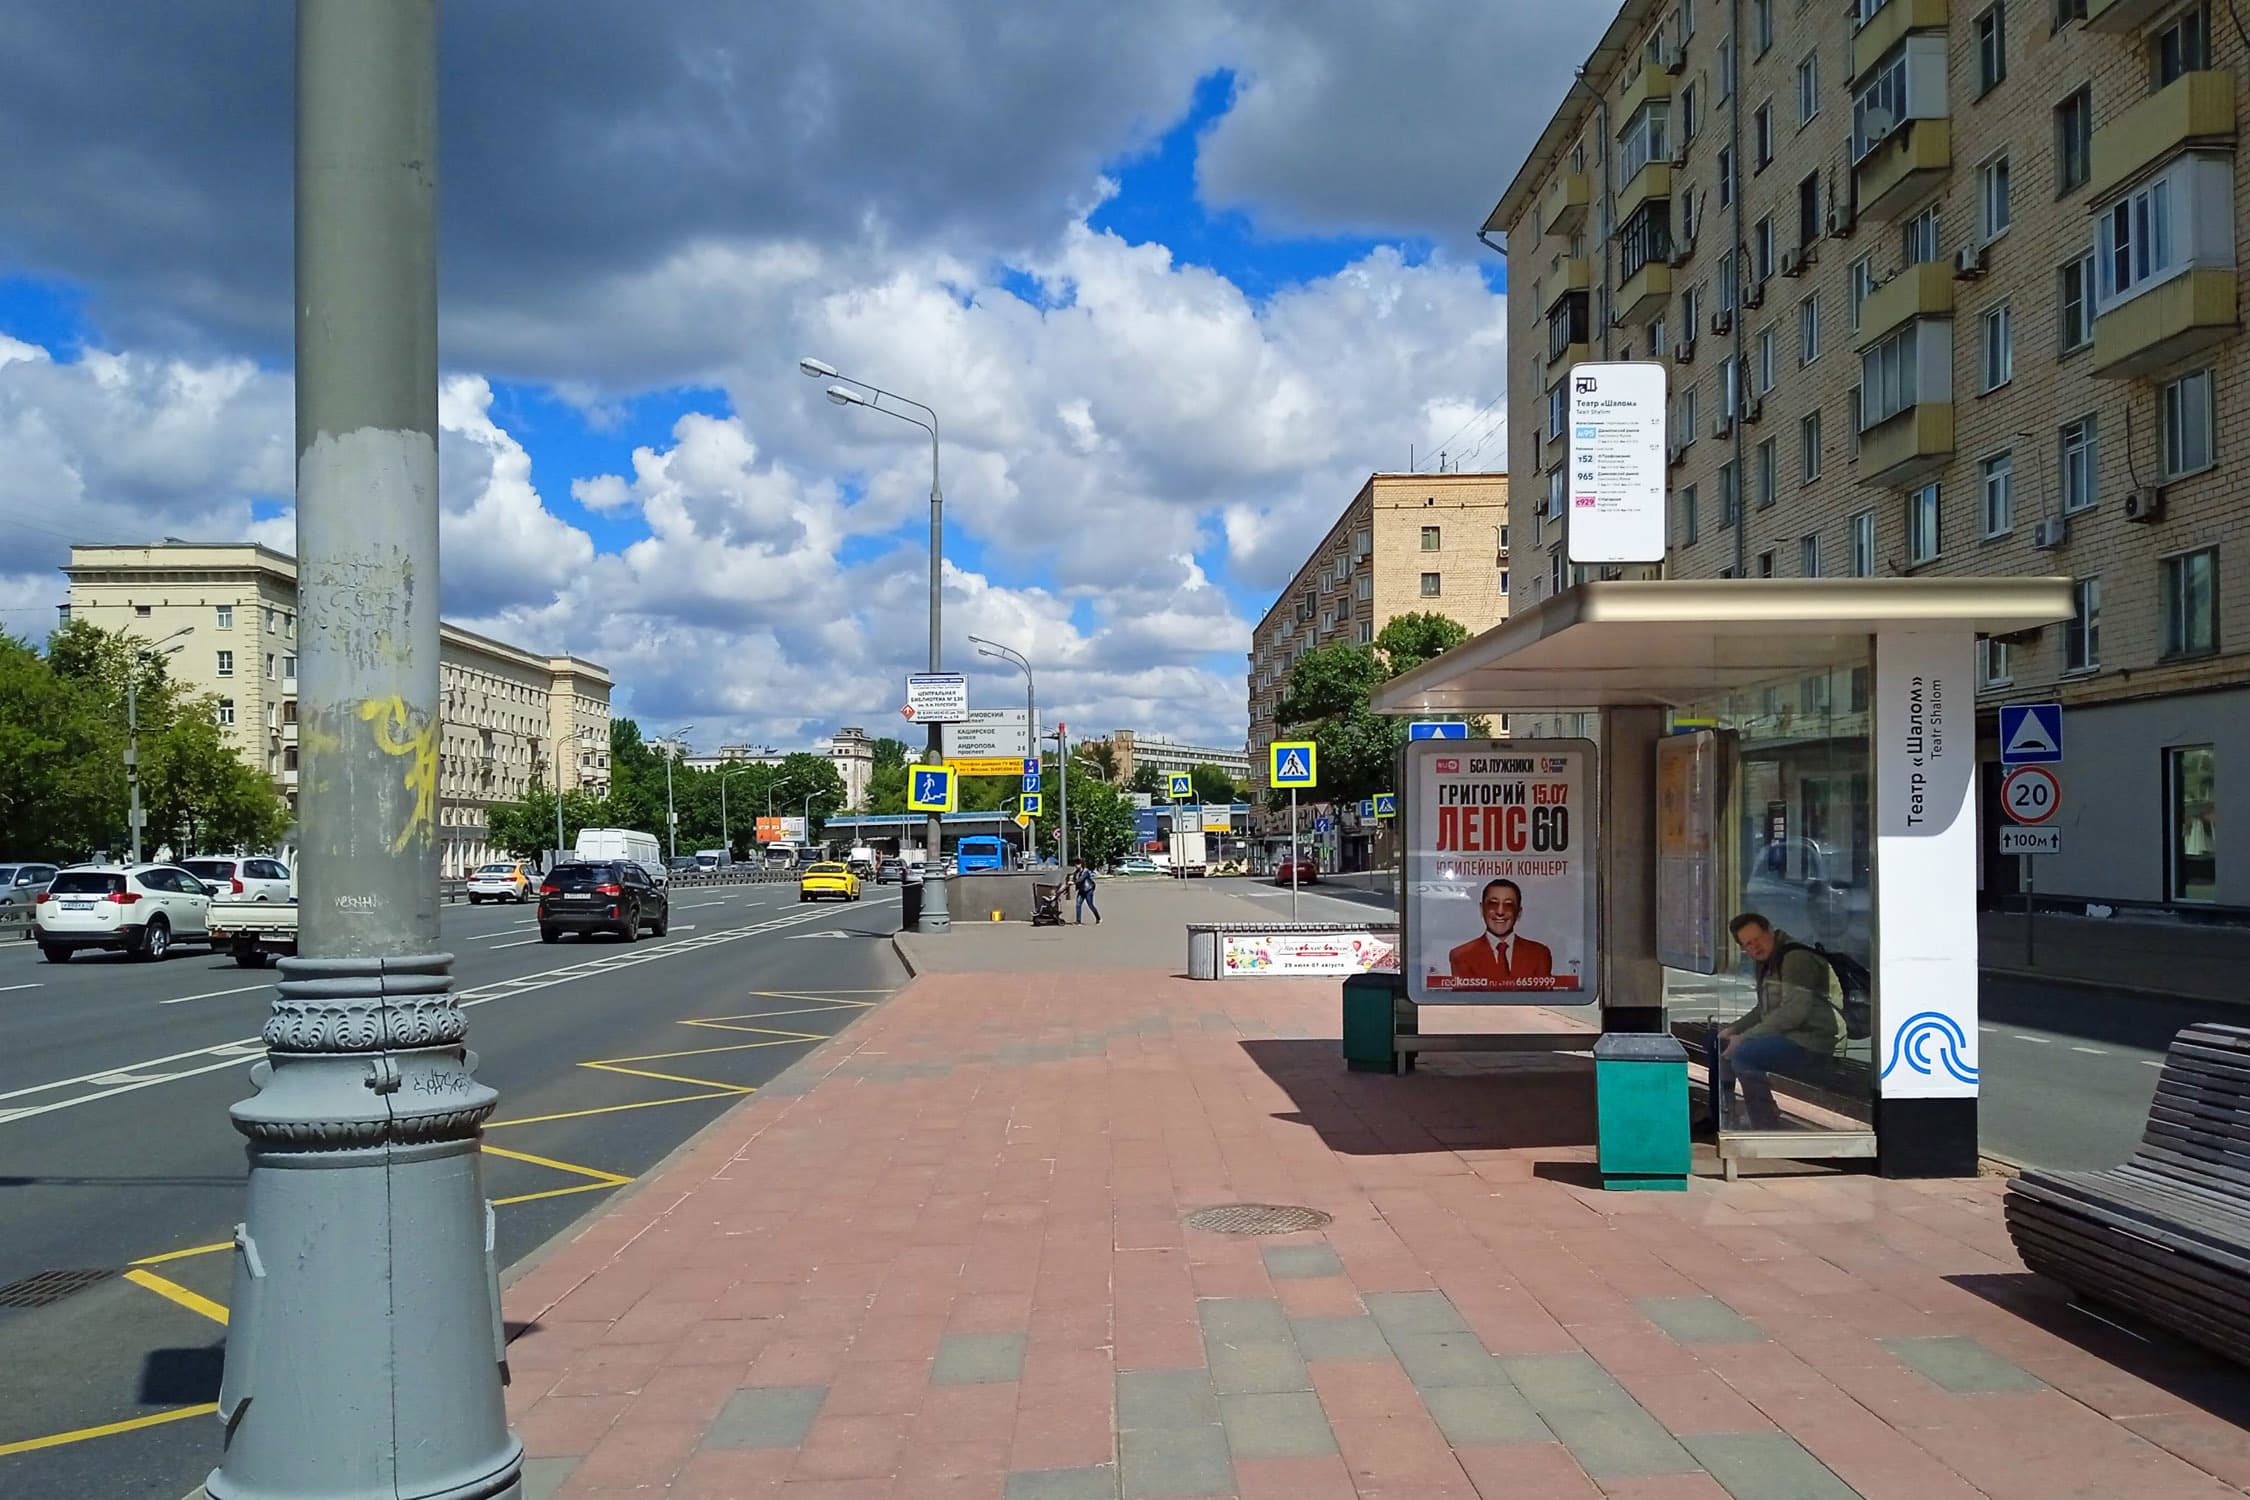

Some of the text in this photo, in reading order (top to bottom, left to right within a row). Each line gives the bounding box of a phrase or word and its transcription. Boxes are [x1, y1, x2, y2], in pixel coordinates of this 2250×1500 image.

[1576, 400, 1599, 408] Театр
[1577, 472, 1594, 481] 965
[1930, 679, 1942, 760] Teatr Shalom
[1907, 676, 1926, 827] Театр «Шалом»
[1470, 759, 1488, 773] БСА
[1489, 759, 1534, 773] ЛУЖНИКИ
[1439, 781, 1568, 805] ГРИГОРИЙ 15.07
[2015, 784, 2048, 806] 20
[1437, 806, 1569, 852] ЛЕПС 60
[2014, 834, 2047, 846] 100м
[1437, 859, 1568, 876] ЮБИЛЕЙНЫЙ КОНЦЕРТ
[1516, 977, 1555, 987] 6659999
